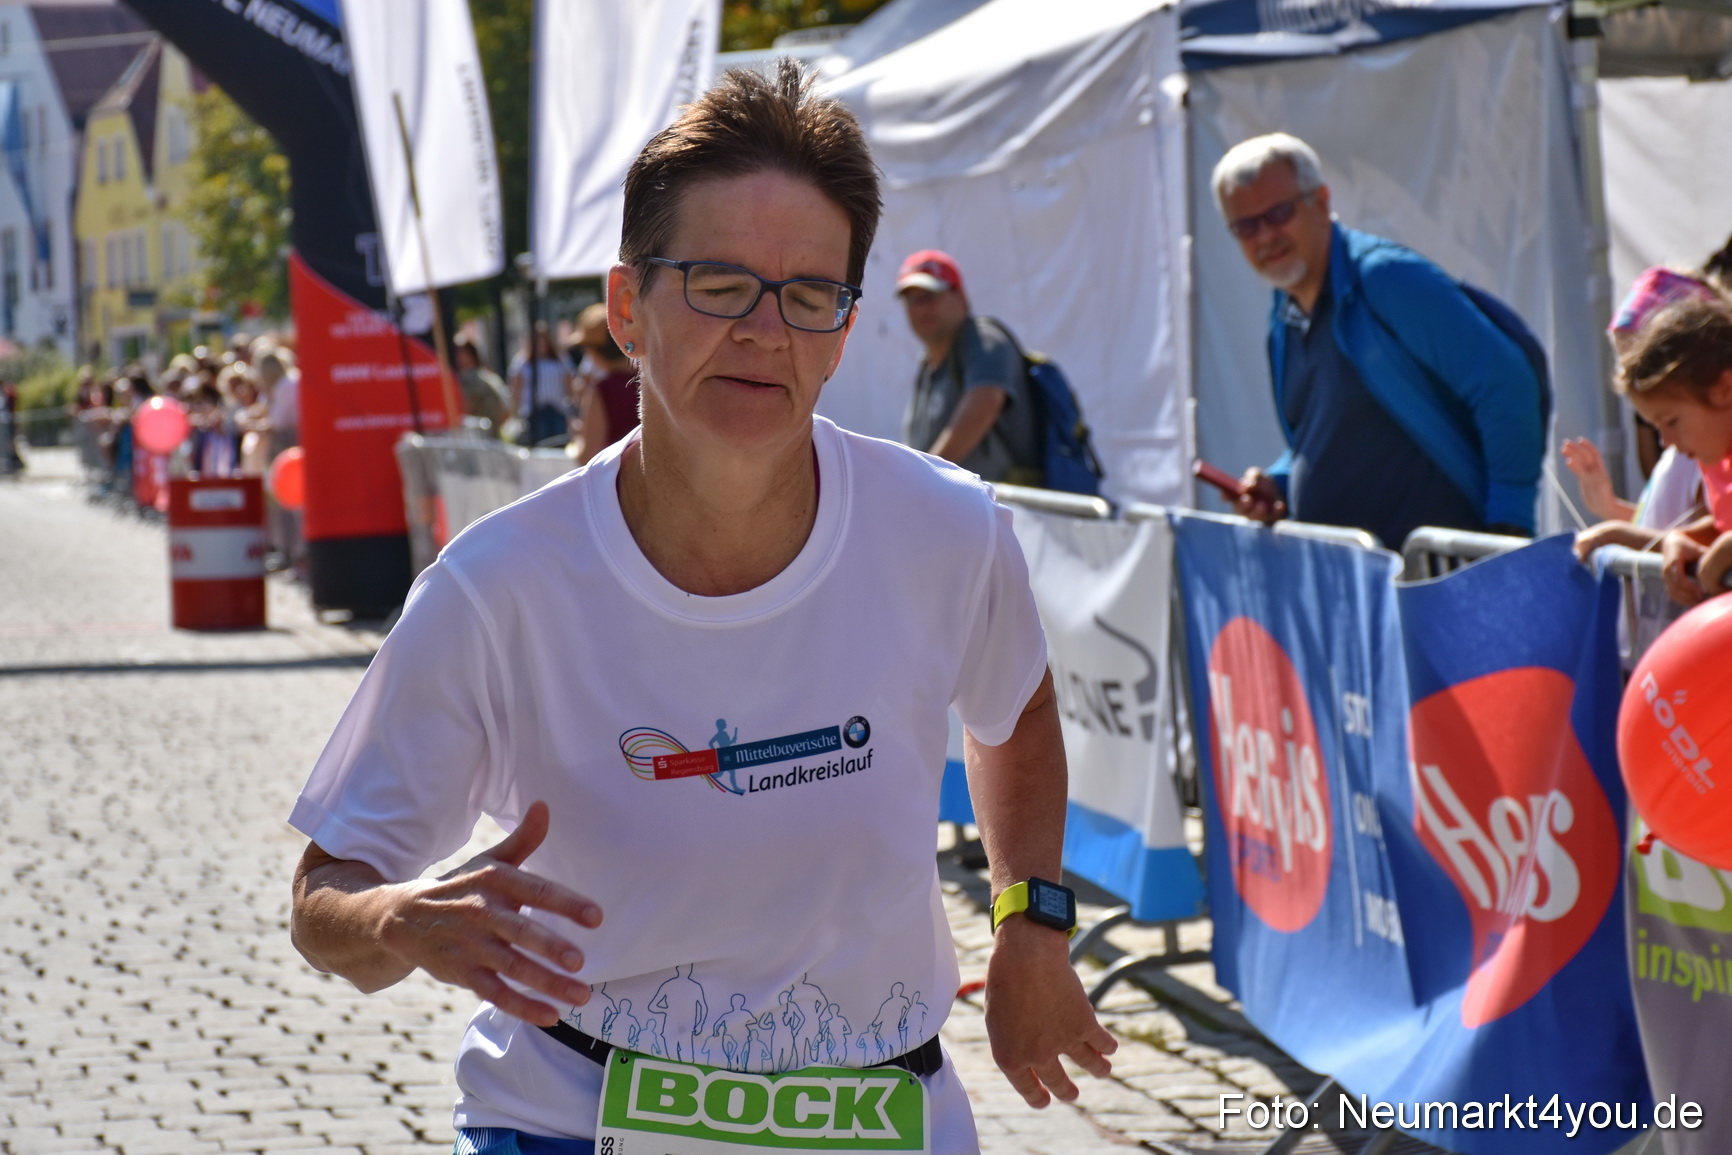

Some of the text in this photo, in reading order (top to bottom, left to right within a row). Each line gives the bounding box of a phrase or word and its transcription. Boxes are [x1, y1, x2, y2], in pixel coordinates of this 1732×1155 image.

[1640, 670, 1716, 789] RÖDL
[669, 756, 707, 768] Sparkasse
[735, 734, 838, 764] Mittelbayerische
[670, 763, 715, 776] Regensburg
[748, 748, 874, 794] Landkreislauf
[627, 1058, 902, 1140] BOCK
